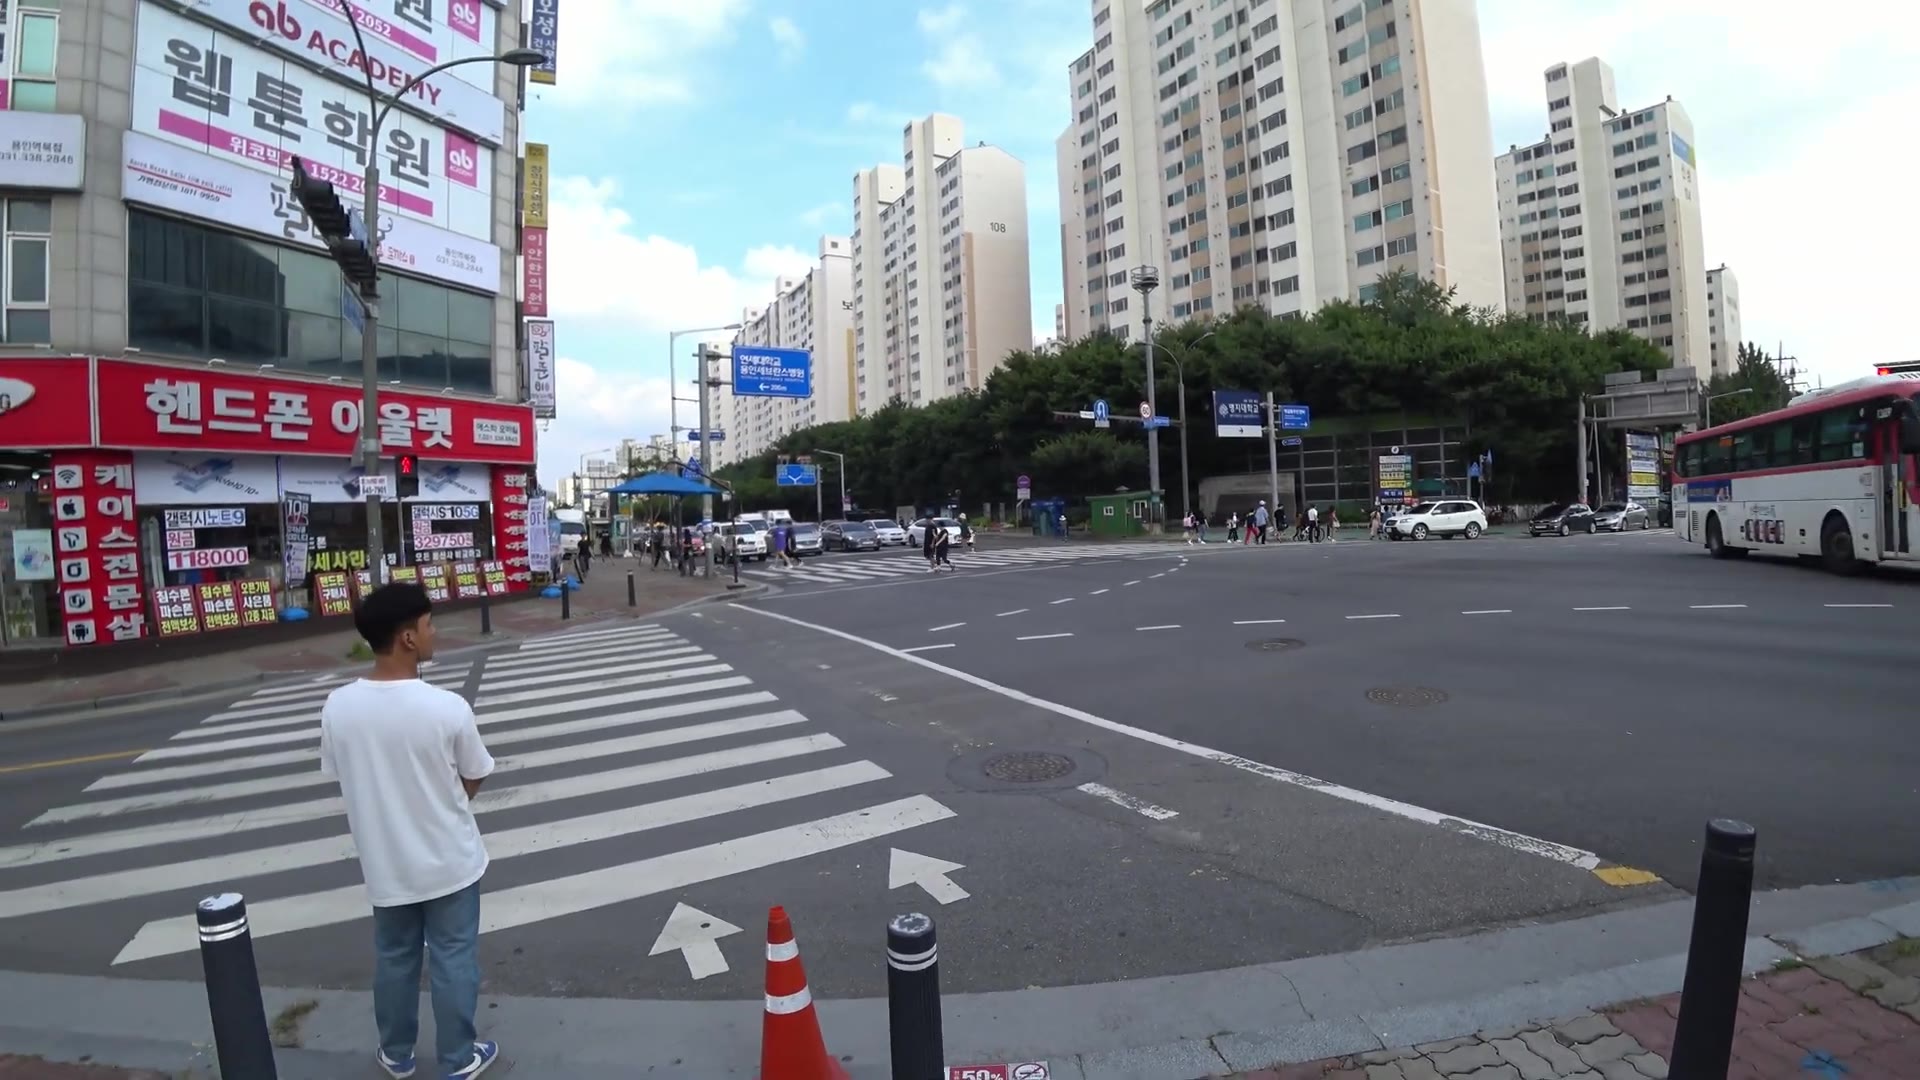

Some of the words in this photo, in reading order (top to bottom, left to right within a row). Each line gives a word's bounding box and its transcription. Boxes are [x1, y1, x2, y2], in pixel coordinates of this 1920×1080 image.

[356, 9, 391, 38] 2052
[453, 3, 477, 24] ab
[249, 0, 301, 41] ab
[307, 30, 441, 106] ACADEMY
[449, 149, 473, 170] ab
[309, 163, 349, 188] 1522
[990, 222, 1006, 233] 108
[144, 378, 313, 441] 핸드폰
[166, 510, 245, 527] 갤럭시노트9
[170, 549, 247, 568] 118000
